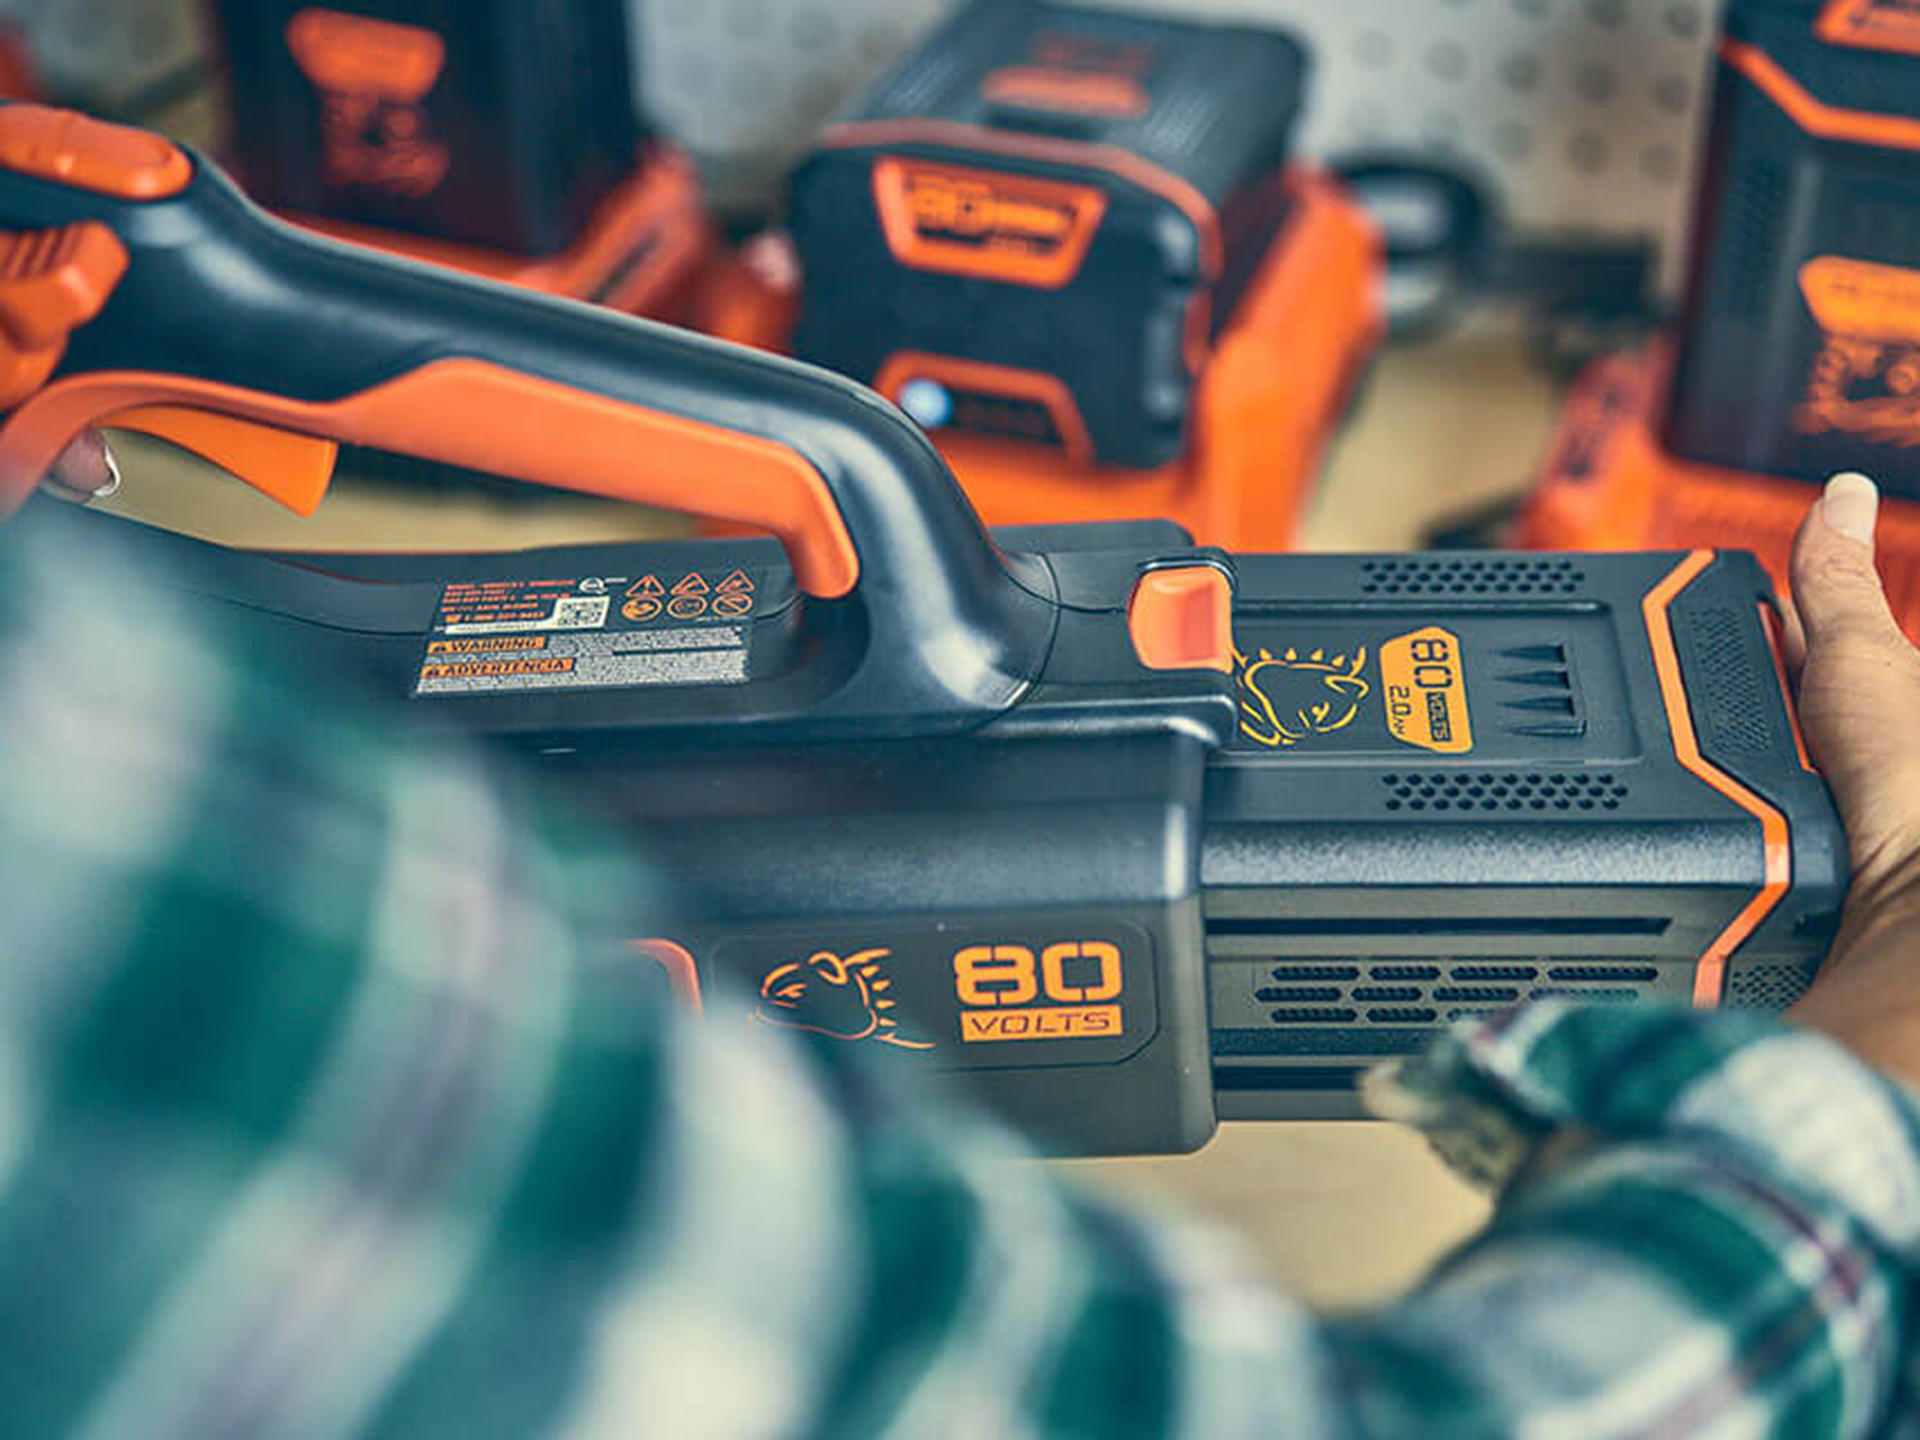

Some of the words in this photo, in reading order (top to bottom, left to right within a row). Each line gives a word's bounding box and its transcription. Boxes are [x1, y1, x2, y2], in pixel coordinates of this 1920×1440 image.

[450, 638, 536, 652] WARNING
[445, 659, 564, 677] ADVERTENCIA
[1410, 638, 1452, 688] 80
[1430, 692, 1450, 740] VOLTS
[953, 942, 1121, 1006] 80
[970, 1012, 1111, 1033] VOLTS
